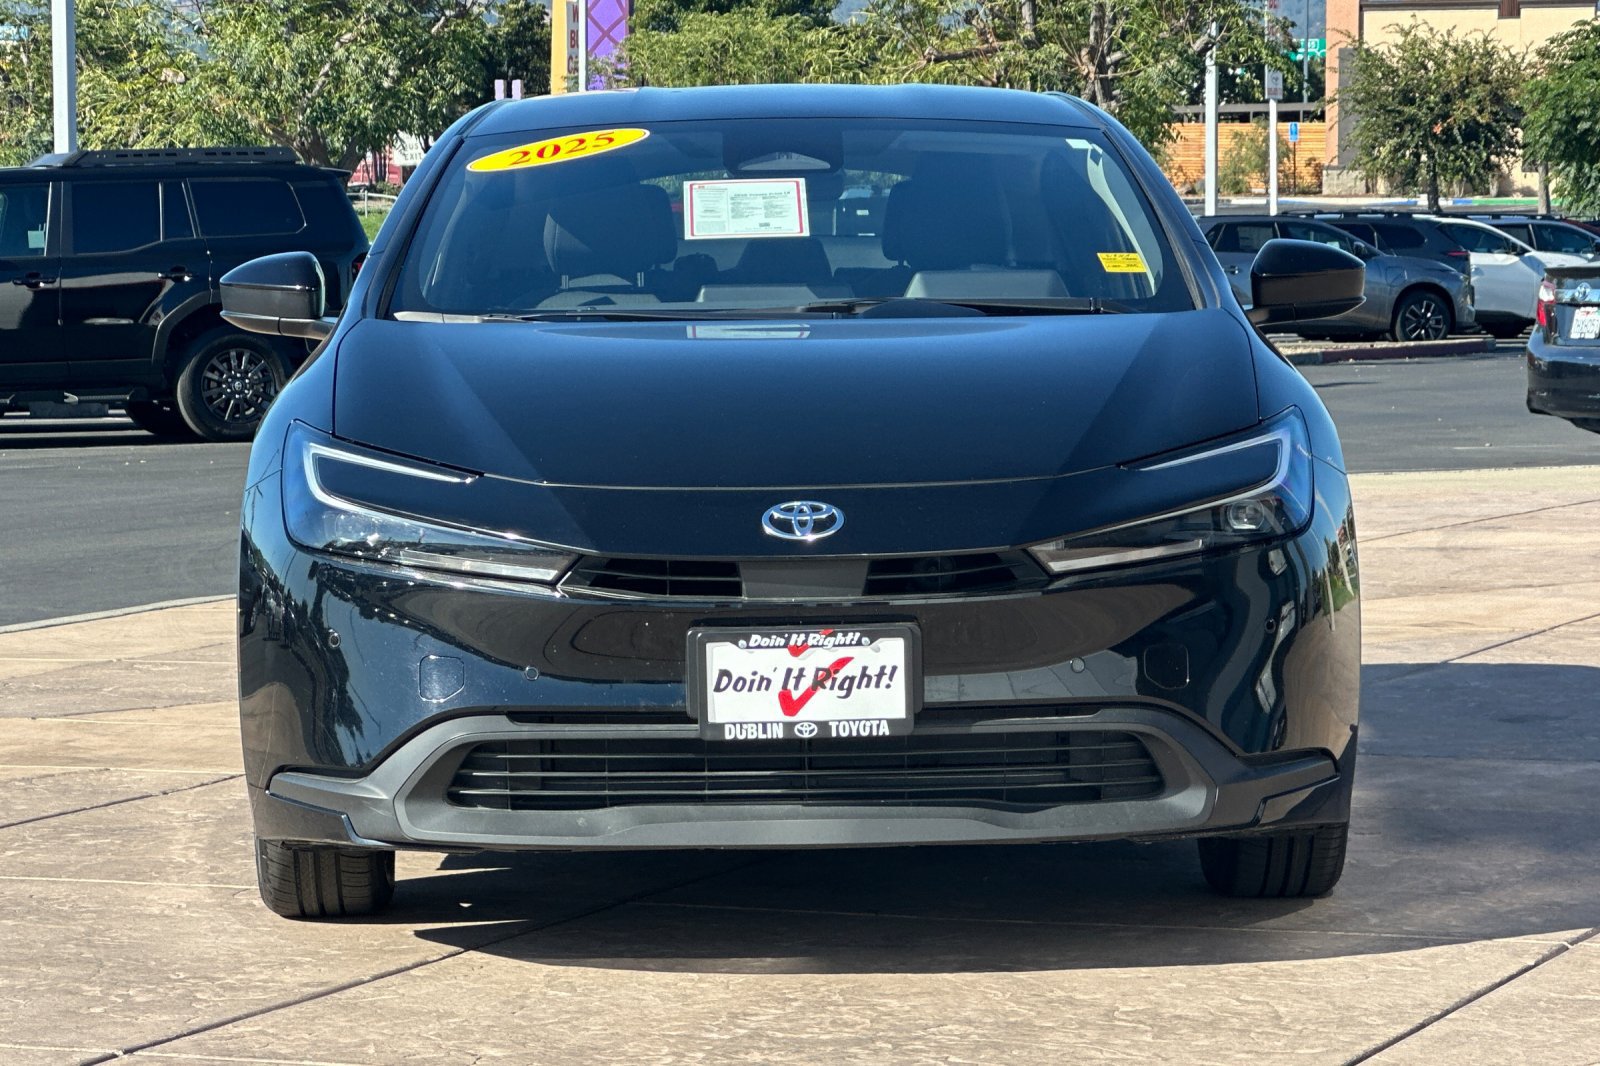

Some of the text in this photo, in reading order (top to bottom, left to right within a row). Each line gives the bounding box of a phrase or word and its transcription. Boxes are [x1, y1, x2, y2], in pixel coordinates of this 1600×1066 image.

[404, 153, 422, 161] EXIT
[508, 131, 615, 166] 2025
[749, 632, 861, 649] Doin' It Right!
[713, 665, 898, 699] Doin' It Right!
[724, 719, 890, 740] DUBLIN TOYOTA
